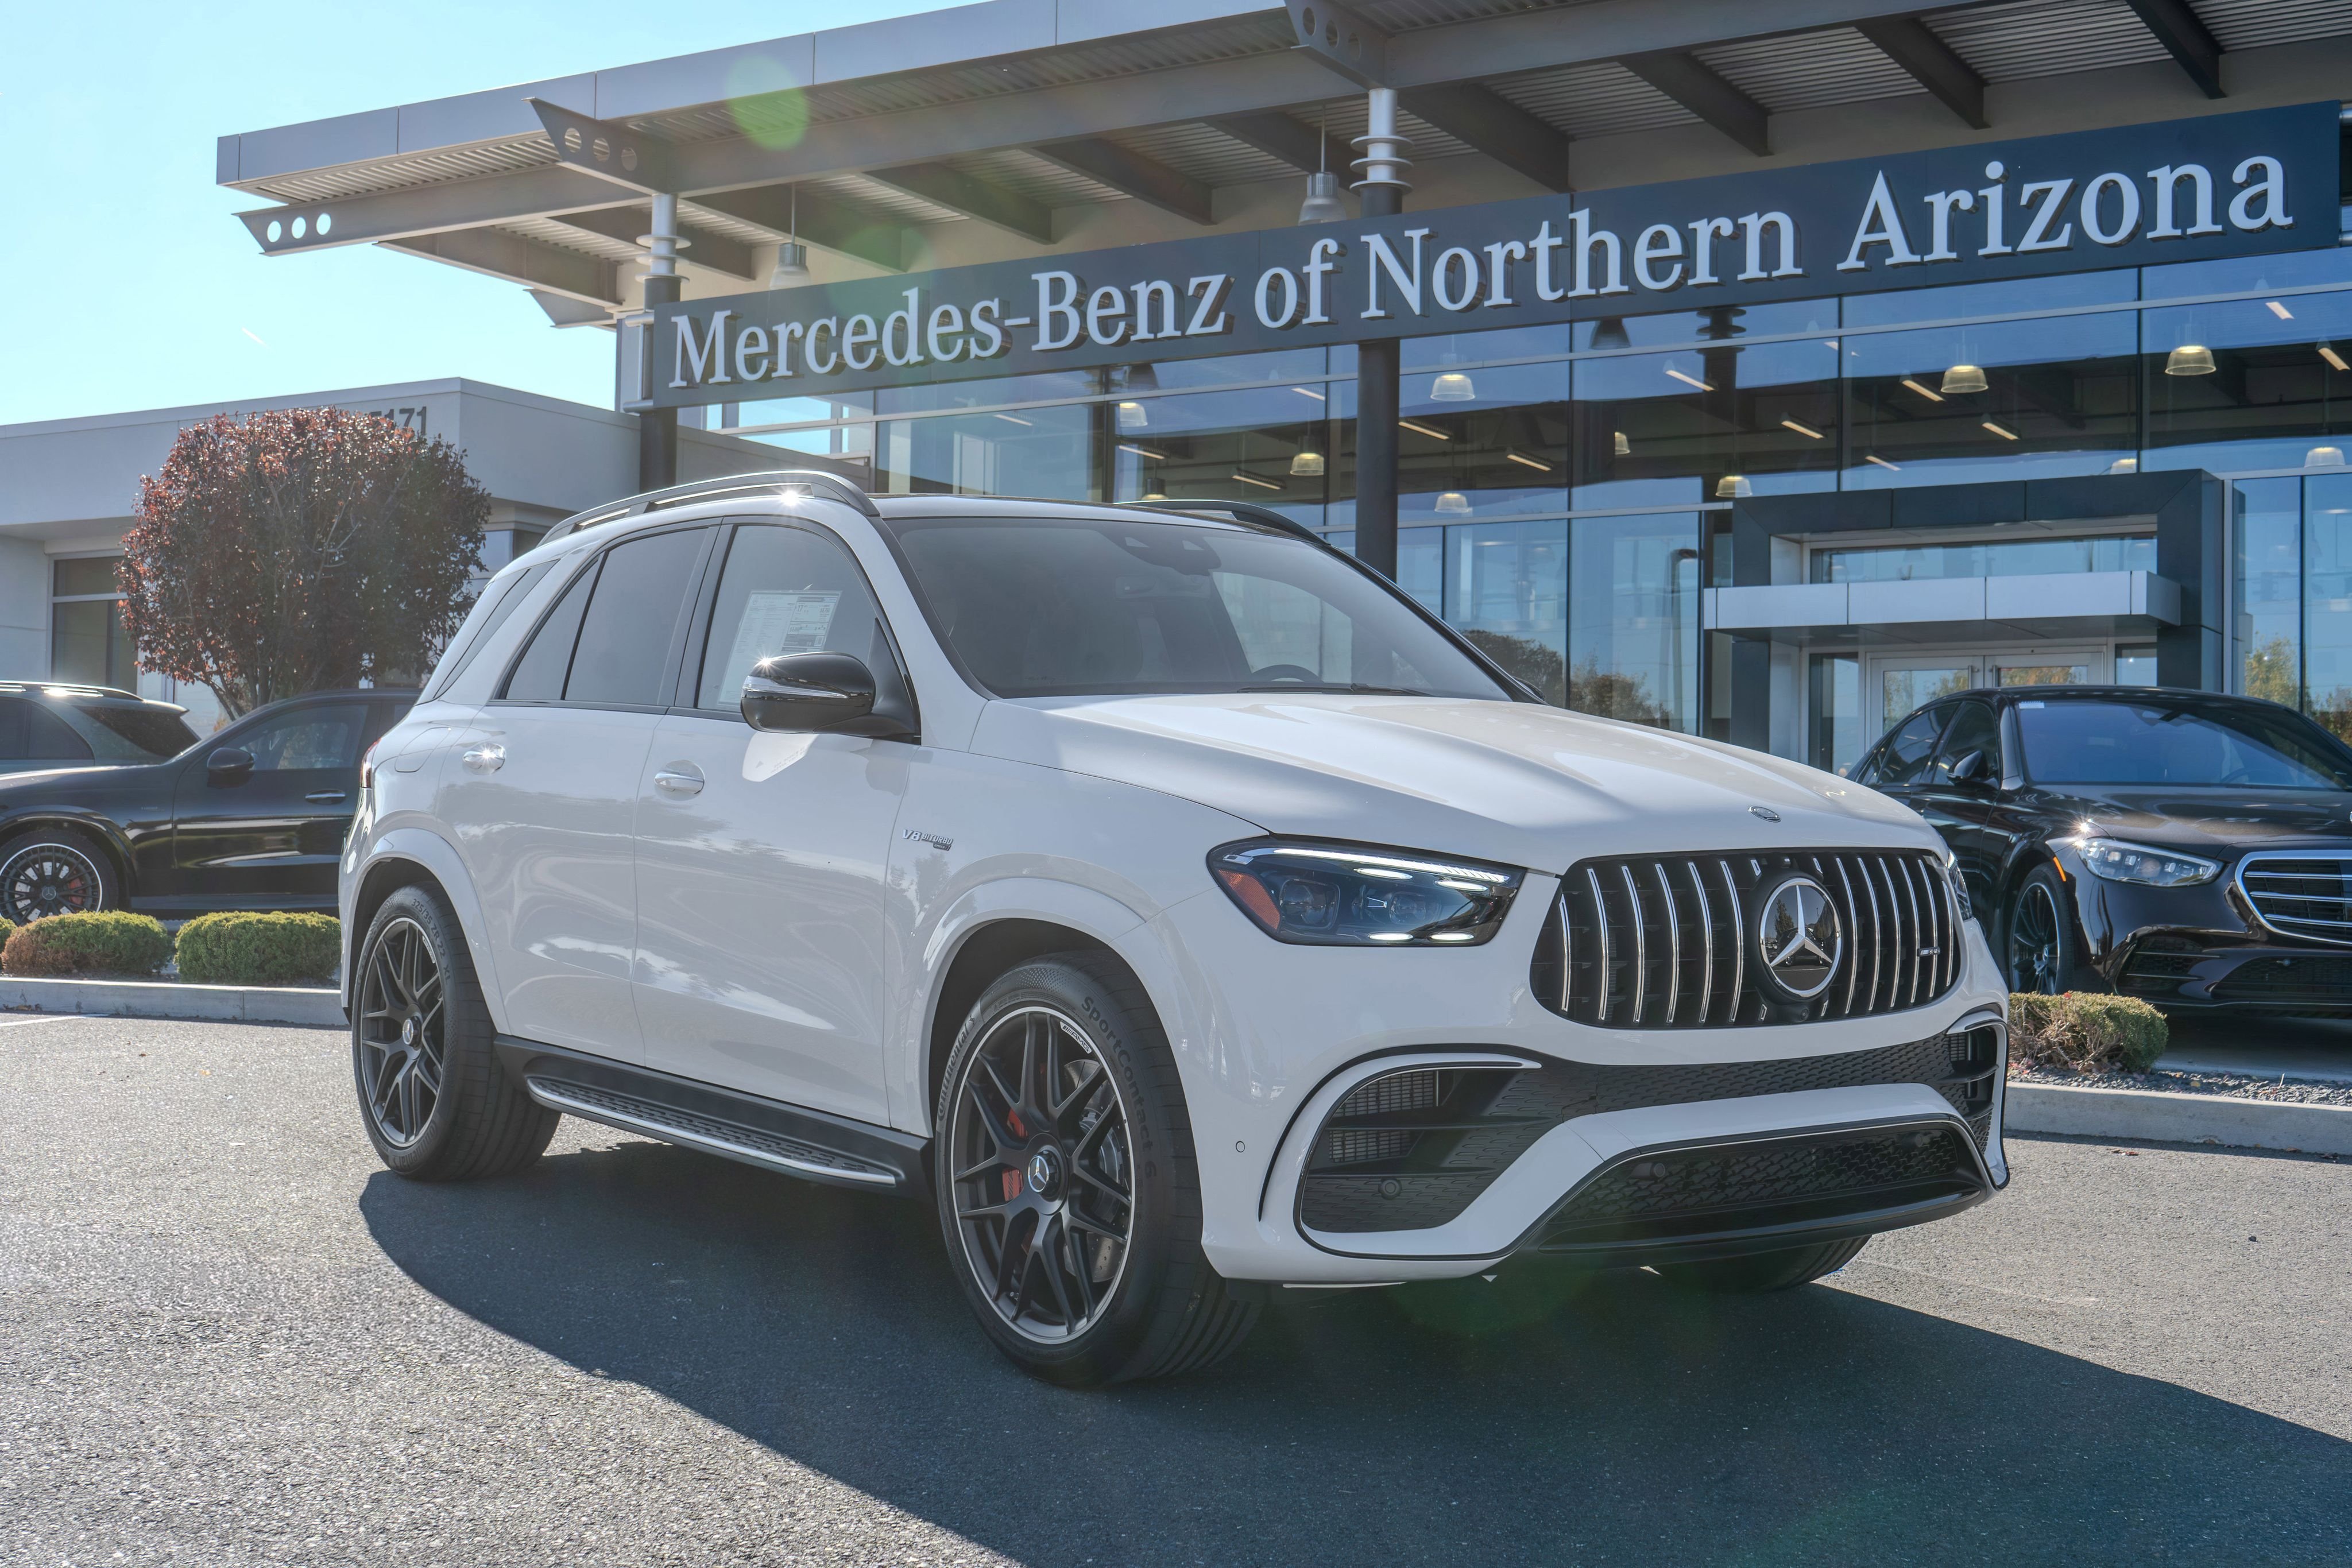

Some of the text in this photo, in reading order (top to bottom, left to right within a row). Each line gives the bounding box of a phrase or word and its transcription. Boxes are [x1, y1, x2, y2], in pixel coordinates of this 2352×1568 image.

[669, 156, 2293, 388] Mercedes-Benz of Northern Arizona
[902, 829, 922, 841] V8
[412, 898, 432, 926] 325/35
[431, 924, 440, 942] ZR
[436, 941, 446, 959] 22
[443, 964, 451, 986] XL
[1081, 996, 1157, 1179] SportContact 6
